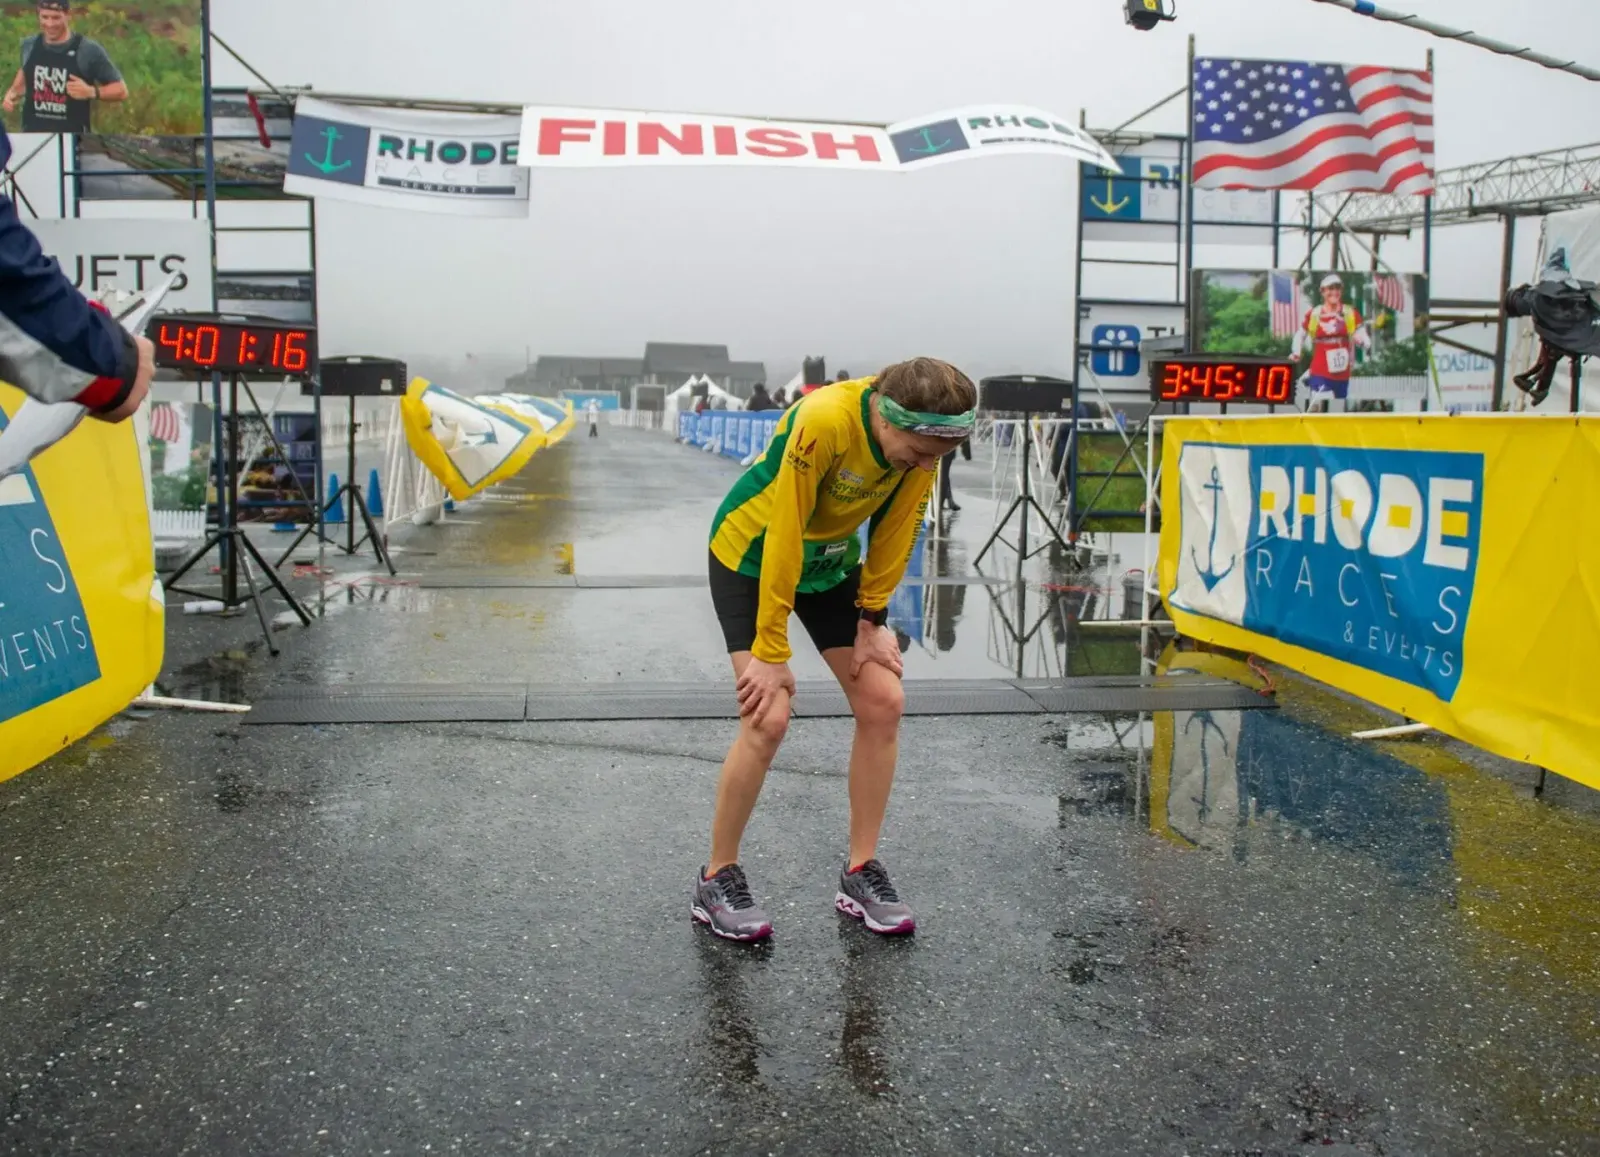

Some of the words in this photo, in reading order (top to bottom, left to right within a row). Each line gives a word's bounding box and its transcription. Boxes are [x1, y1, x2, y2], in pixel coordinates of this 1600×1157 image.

[34, 65, 67, 81] RUN
[34, 101, 67, 113] LATER
[377, 134, 519, 166] RHODE
[537, 118, 882, 162] FINISH
[159, 325, 308, 371] 4:01:16
[1162, 364, 1290, 400] 3:45:10
[1258, 465, 1474, 571] RHODE
[1255, 548, 1463, 635] RACES
[1343, 620, 1355, 644] &
[1368, 626, 1454, 678] EVETS
